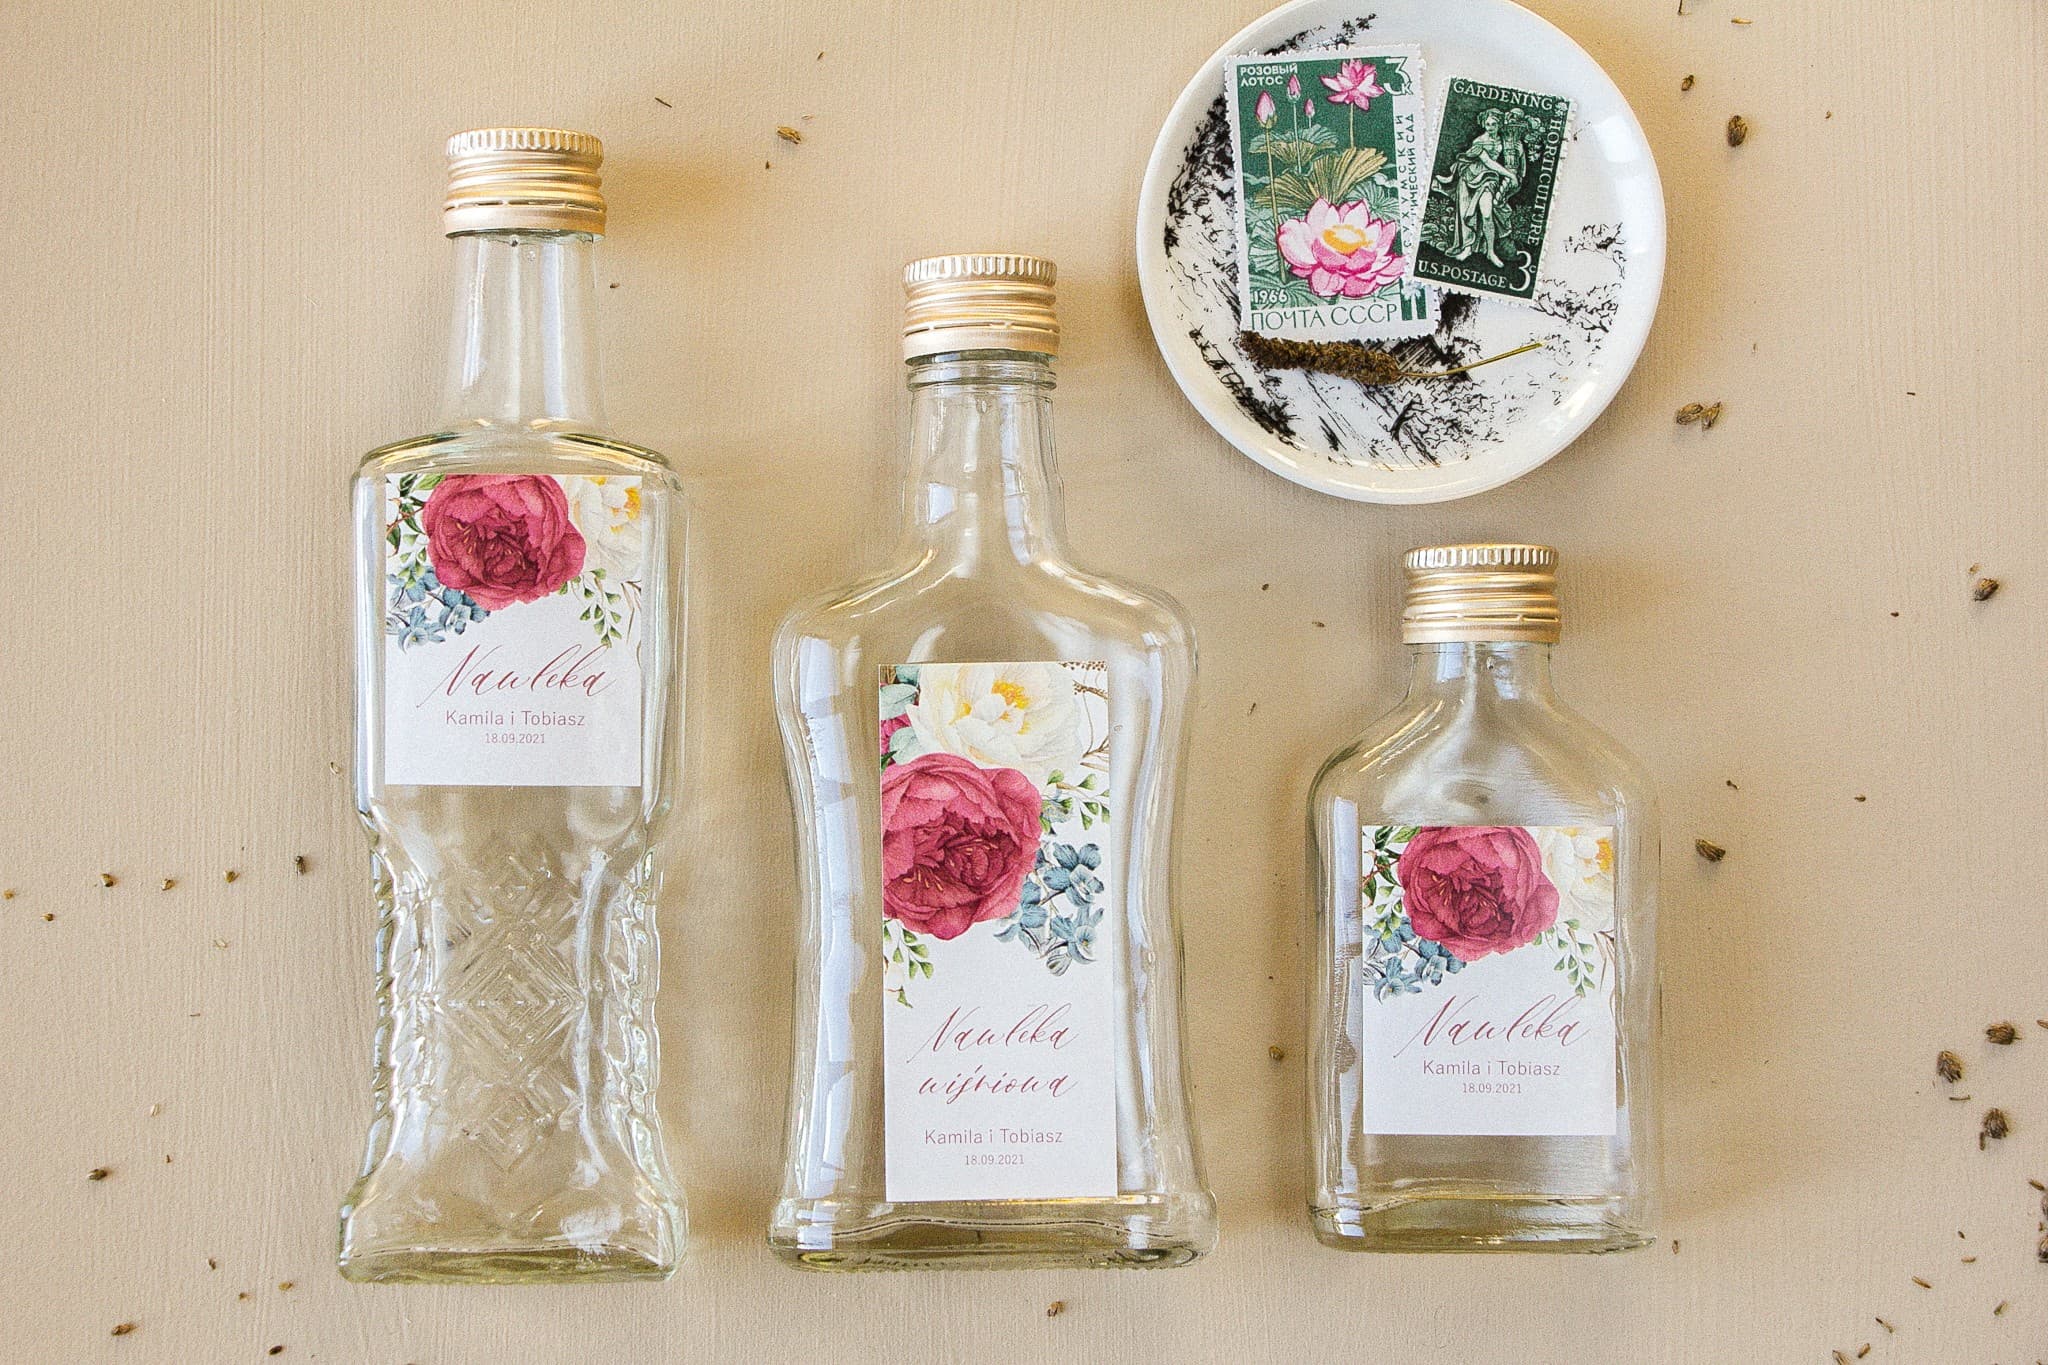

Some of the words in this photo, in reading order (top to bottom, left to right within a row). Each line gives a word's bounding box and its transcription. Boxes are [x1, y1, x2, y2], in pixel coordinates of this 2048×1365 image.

[1240, 62, 1298, 76] РОЗОВЫЙ
[1240, 75, 1284, 87] ЛОТОС
[1453, 80, 1553, 111] GARDENING
[1527, 119, 1562, 246] HORTICULTURE
[1253, 290, 1288, 305] 1966
[1250, 307, 1326, 331] ПОЧТА
[1330, 303, 1397, 326] СССР
[445, 710, 505, 726] Kamila
[510, 710, 515, 726] i
[521, 710, 586, 726] Tobiasz
[485, 732, 546, 744] 18.09.2021
[1423, 1060, 1481, 1076] Kamila
[1487, 1060, 1492, 1076] i
[1498, 1060, 1561, 1076] Tobiasz
[1462, 1082, 1523, 1094] 18.09.2021
[924, 1128, 983, 1145] Kamila
[989, 1128, 994, 1144] i
[999, 1128, 1064, 1144] Tobiasz
[964, 1154, 1025, 1166] 18.09.2021
